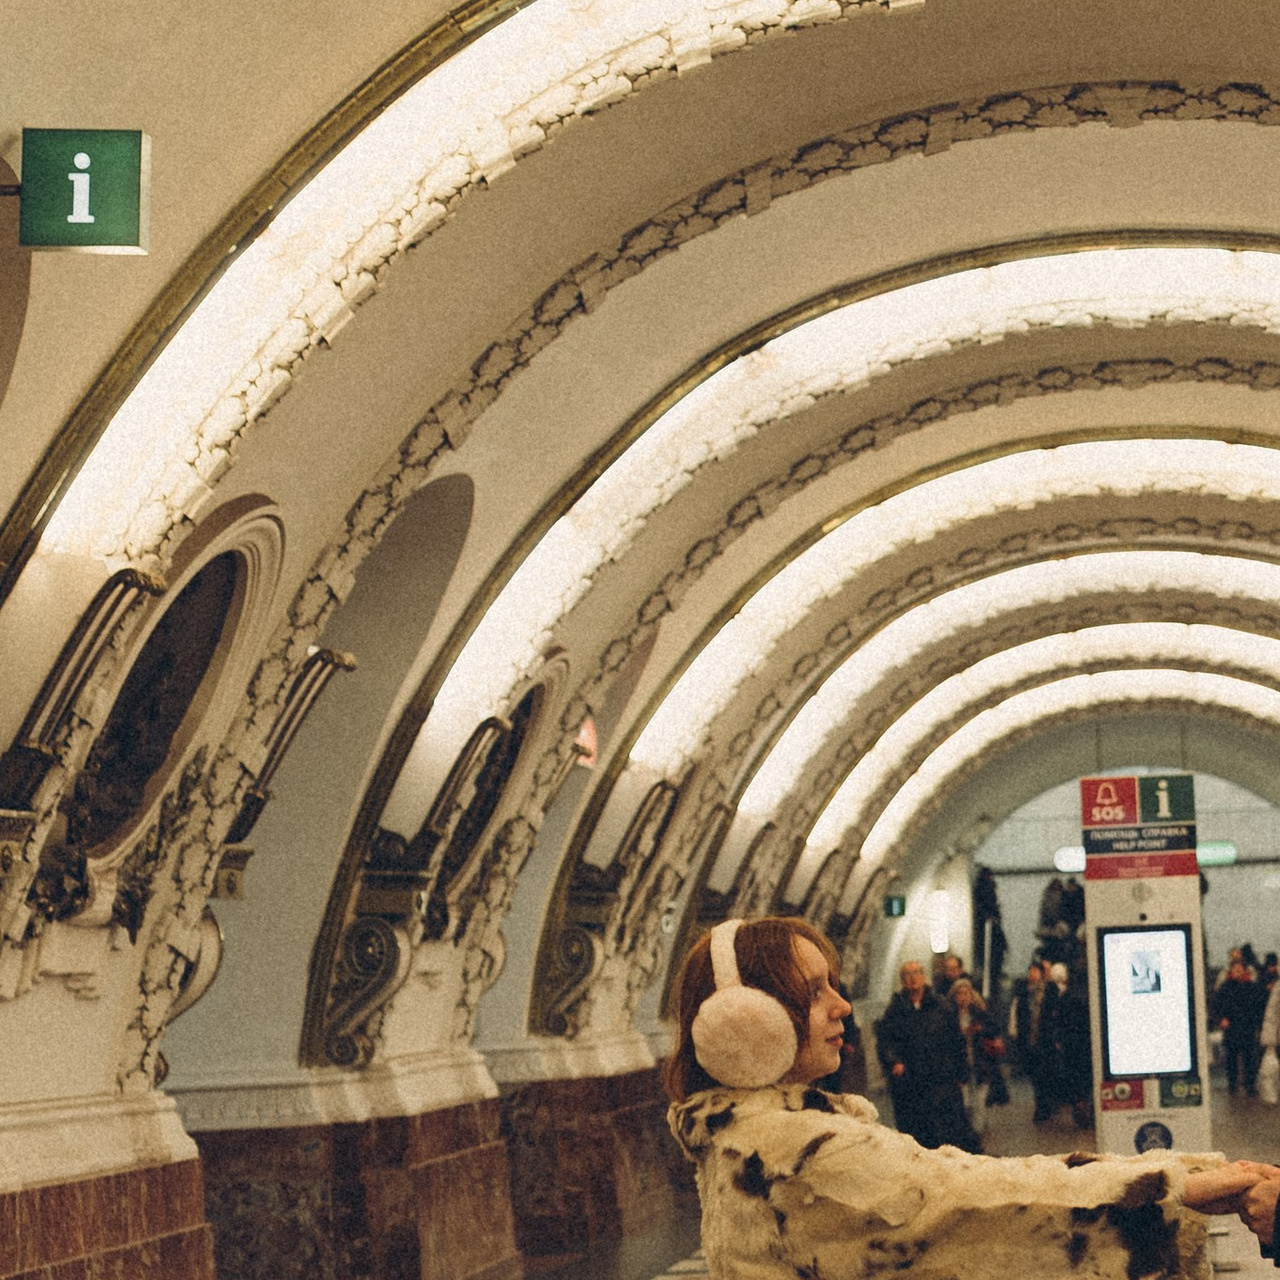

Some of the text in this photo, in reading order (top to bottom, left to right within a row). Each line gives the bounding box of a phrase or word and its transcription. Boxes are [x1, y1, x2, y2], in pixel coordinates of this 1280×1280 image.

[66, 151, 96, 224] i
[1155, 779, 1172, 819] i
[1091, 805, 1126, 822] SOS
[1112, 838, 1167, 851] HELP POINT
